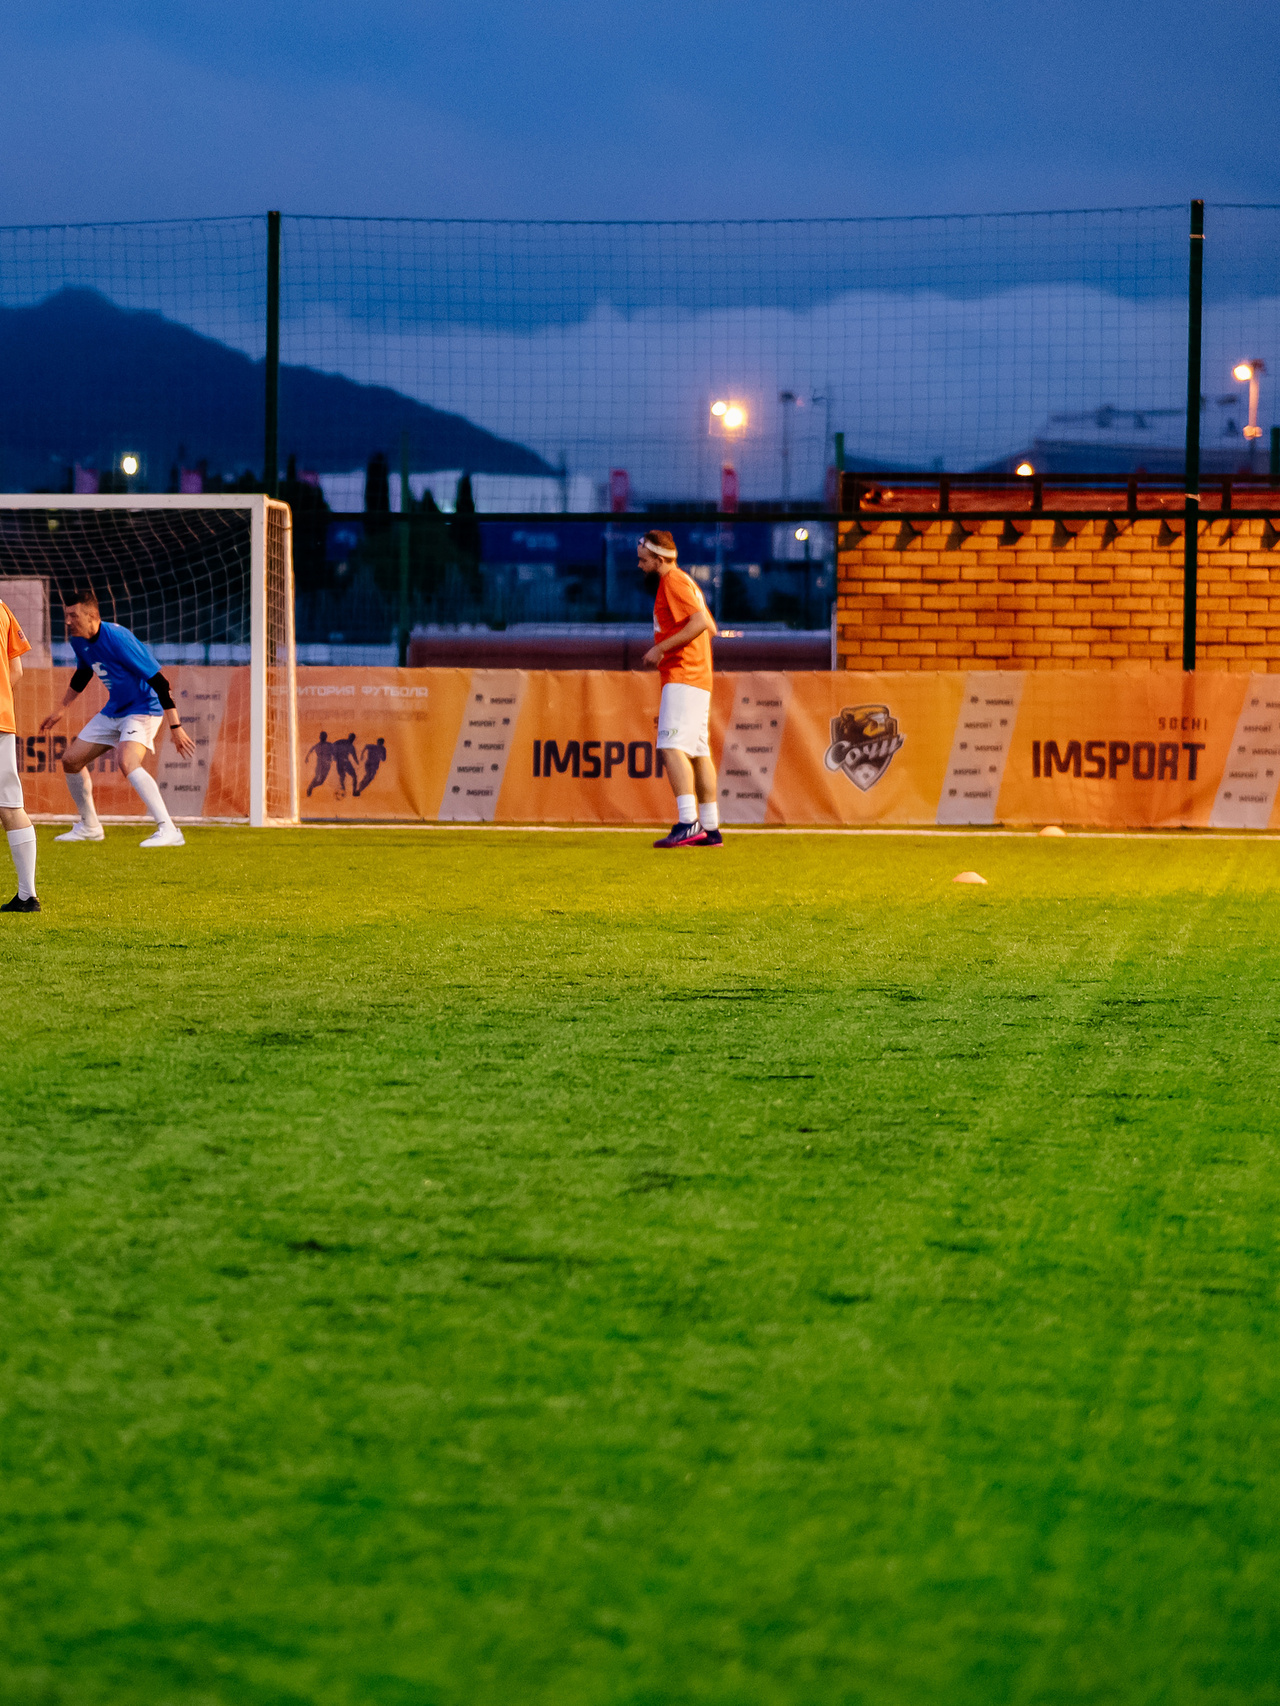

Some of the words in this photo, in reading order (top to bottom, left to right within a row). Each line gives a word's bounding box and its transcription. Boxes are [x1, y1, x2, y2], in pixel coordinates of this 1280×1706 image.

[361, 685, 429, 698] ФУТБОЛА
[1158, 717, 1208, 732] SOCHI
[1031, 740, 1206, 781] IMSPORT
